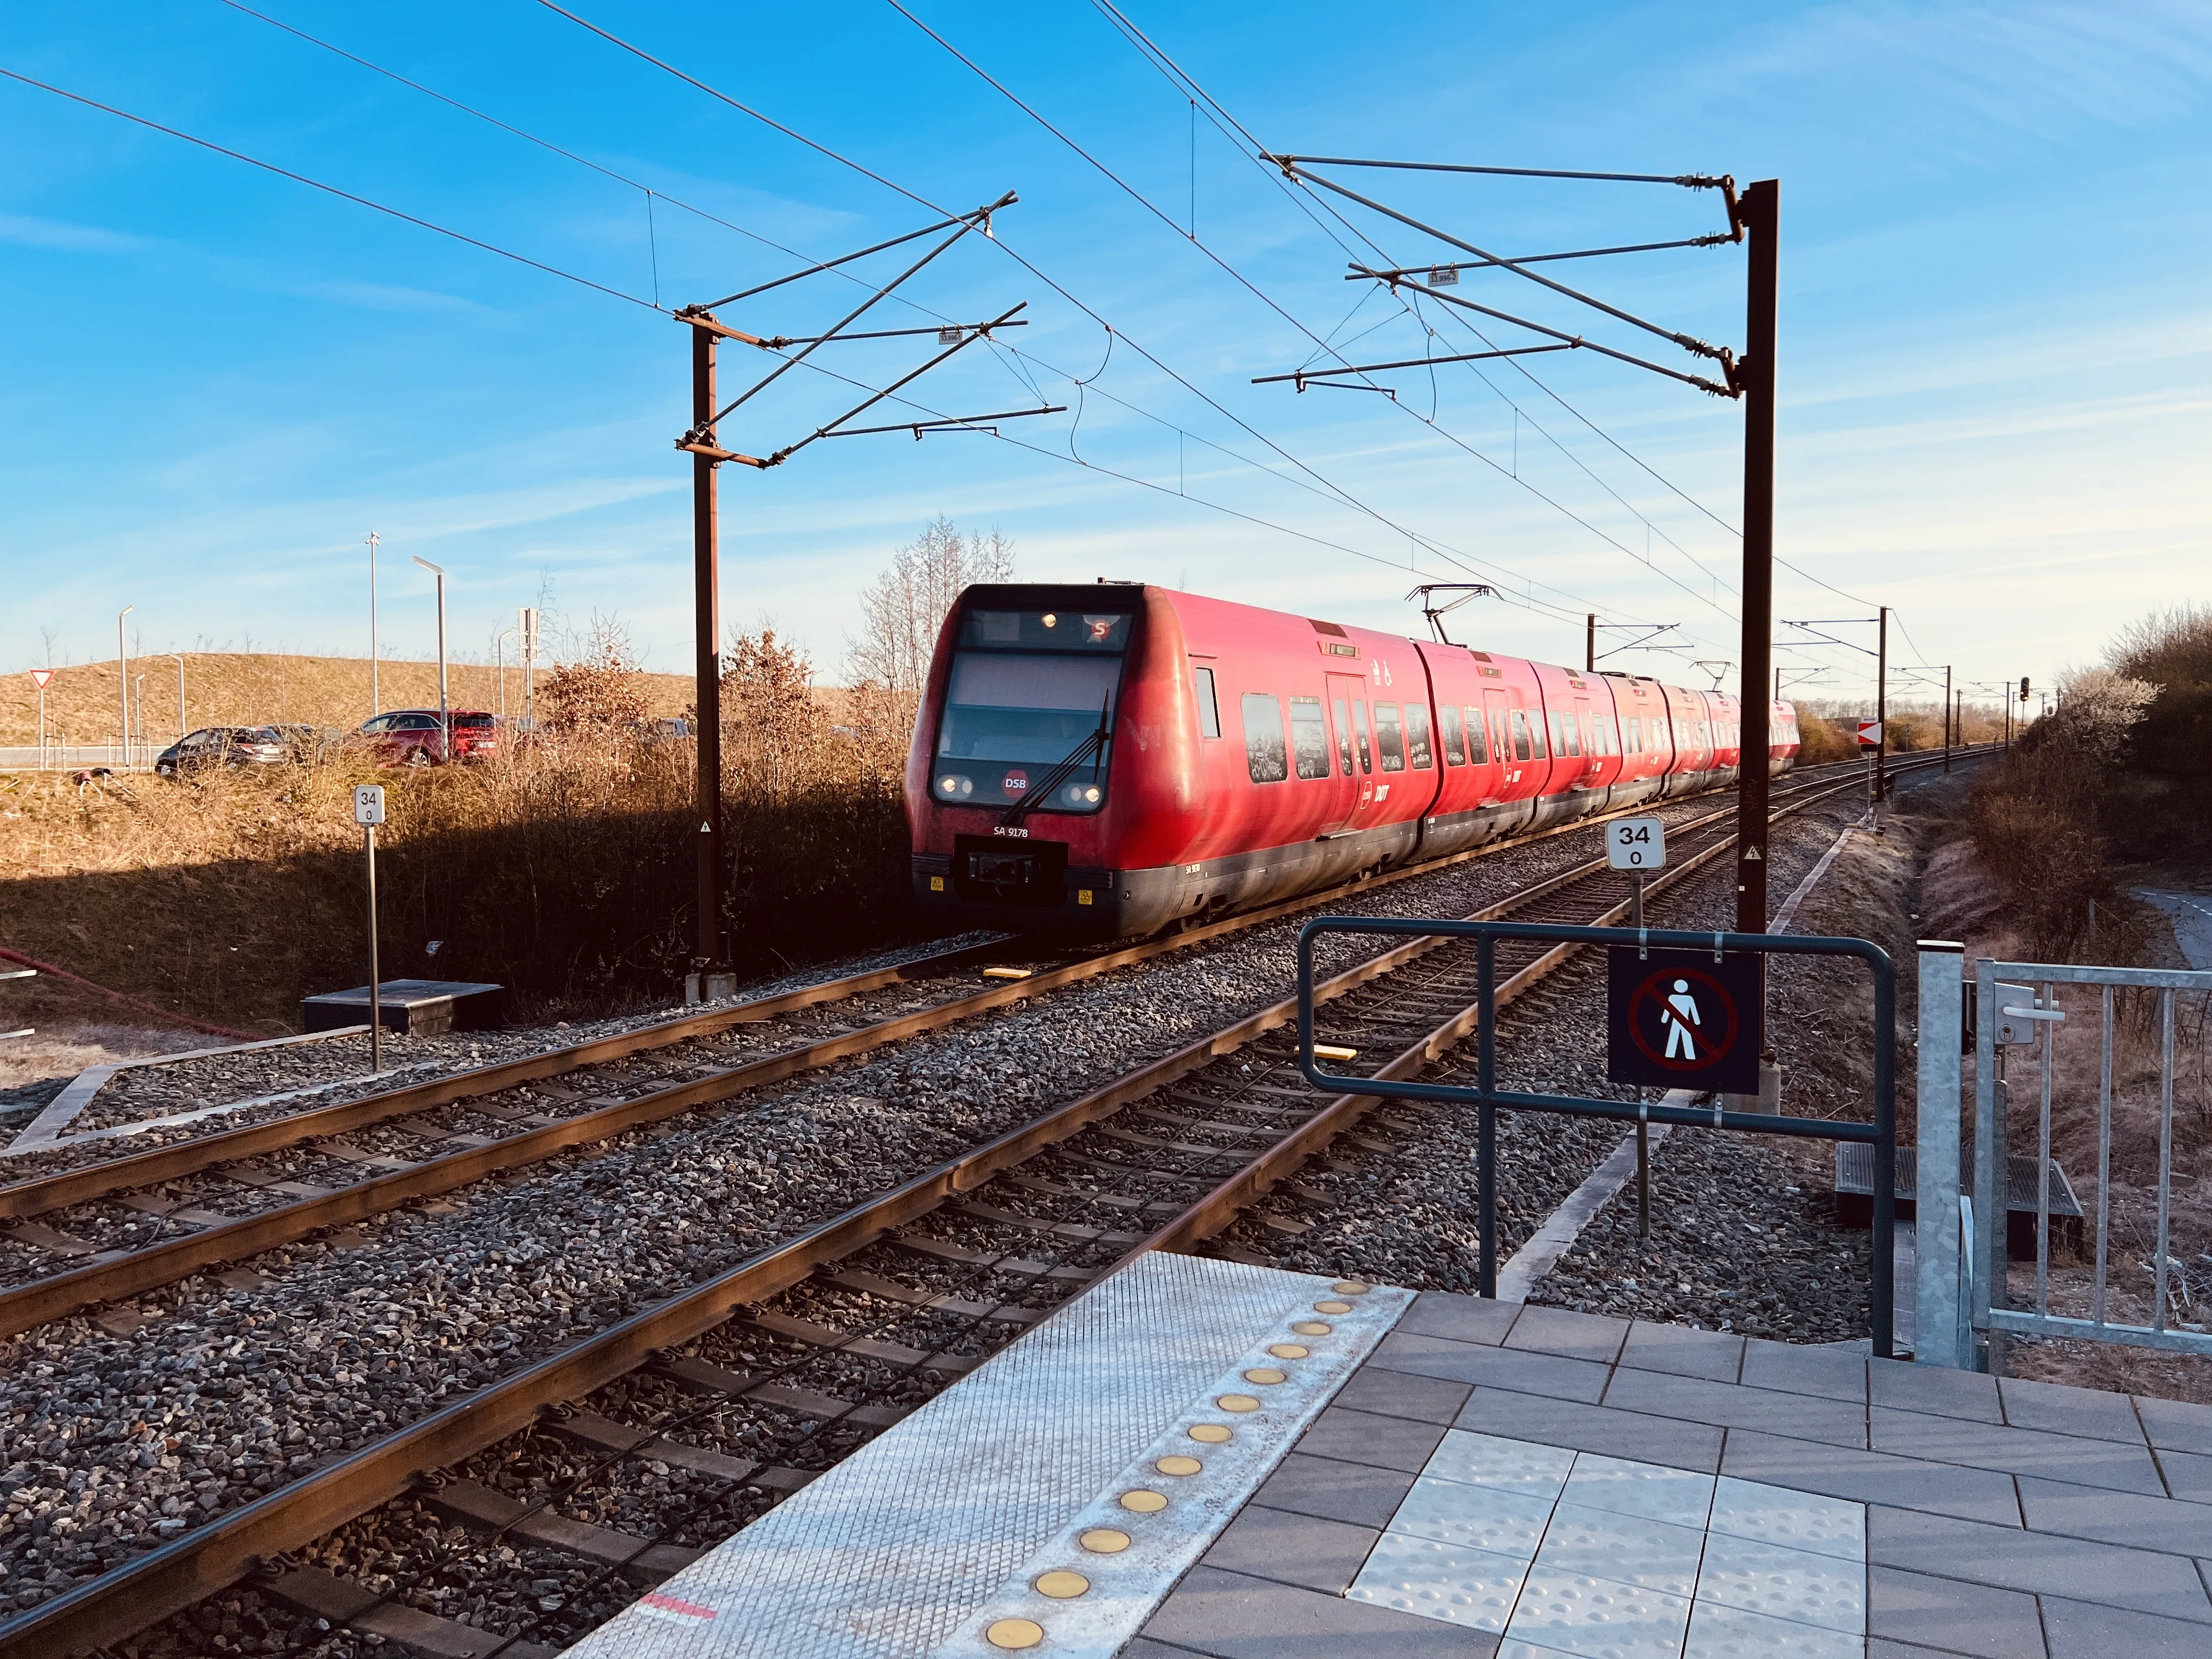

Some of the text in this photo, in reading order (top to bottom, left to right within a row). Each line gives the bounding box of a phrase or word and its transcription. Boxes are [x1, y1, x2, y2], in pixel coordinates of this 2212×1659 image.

[1430, 274, 1457, 283] 33.996-2
[1094, 622, 1105, 635] S
[1005, 778, 1026, 789] DSB
[361, 792, 376, 805] 34
[366, 810, 373, 820] 0
[994, 826, 1028, 838] SA 9178
[1619, 826, 1650, 845] 34
[1630, 851, 1642, 865] 0
